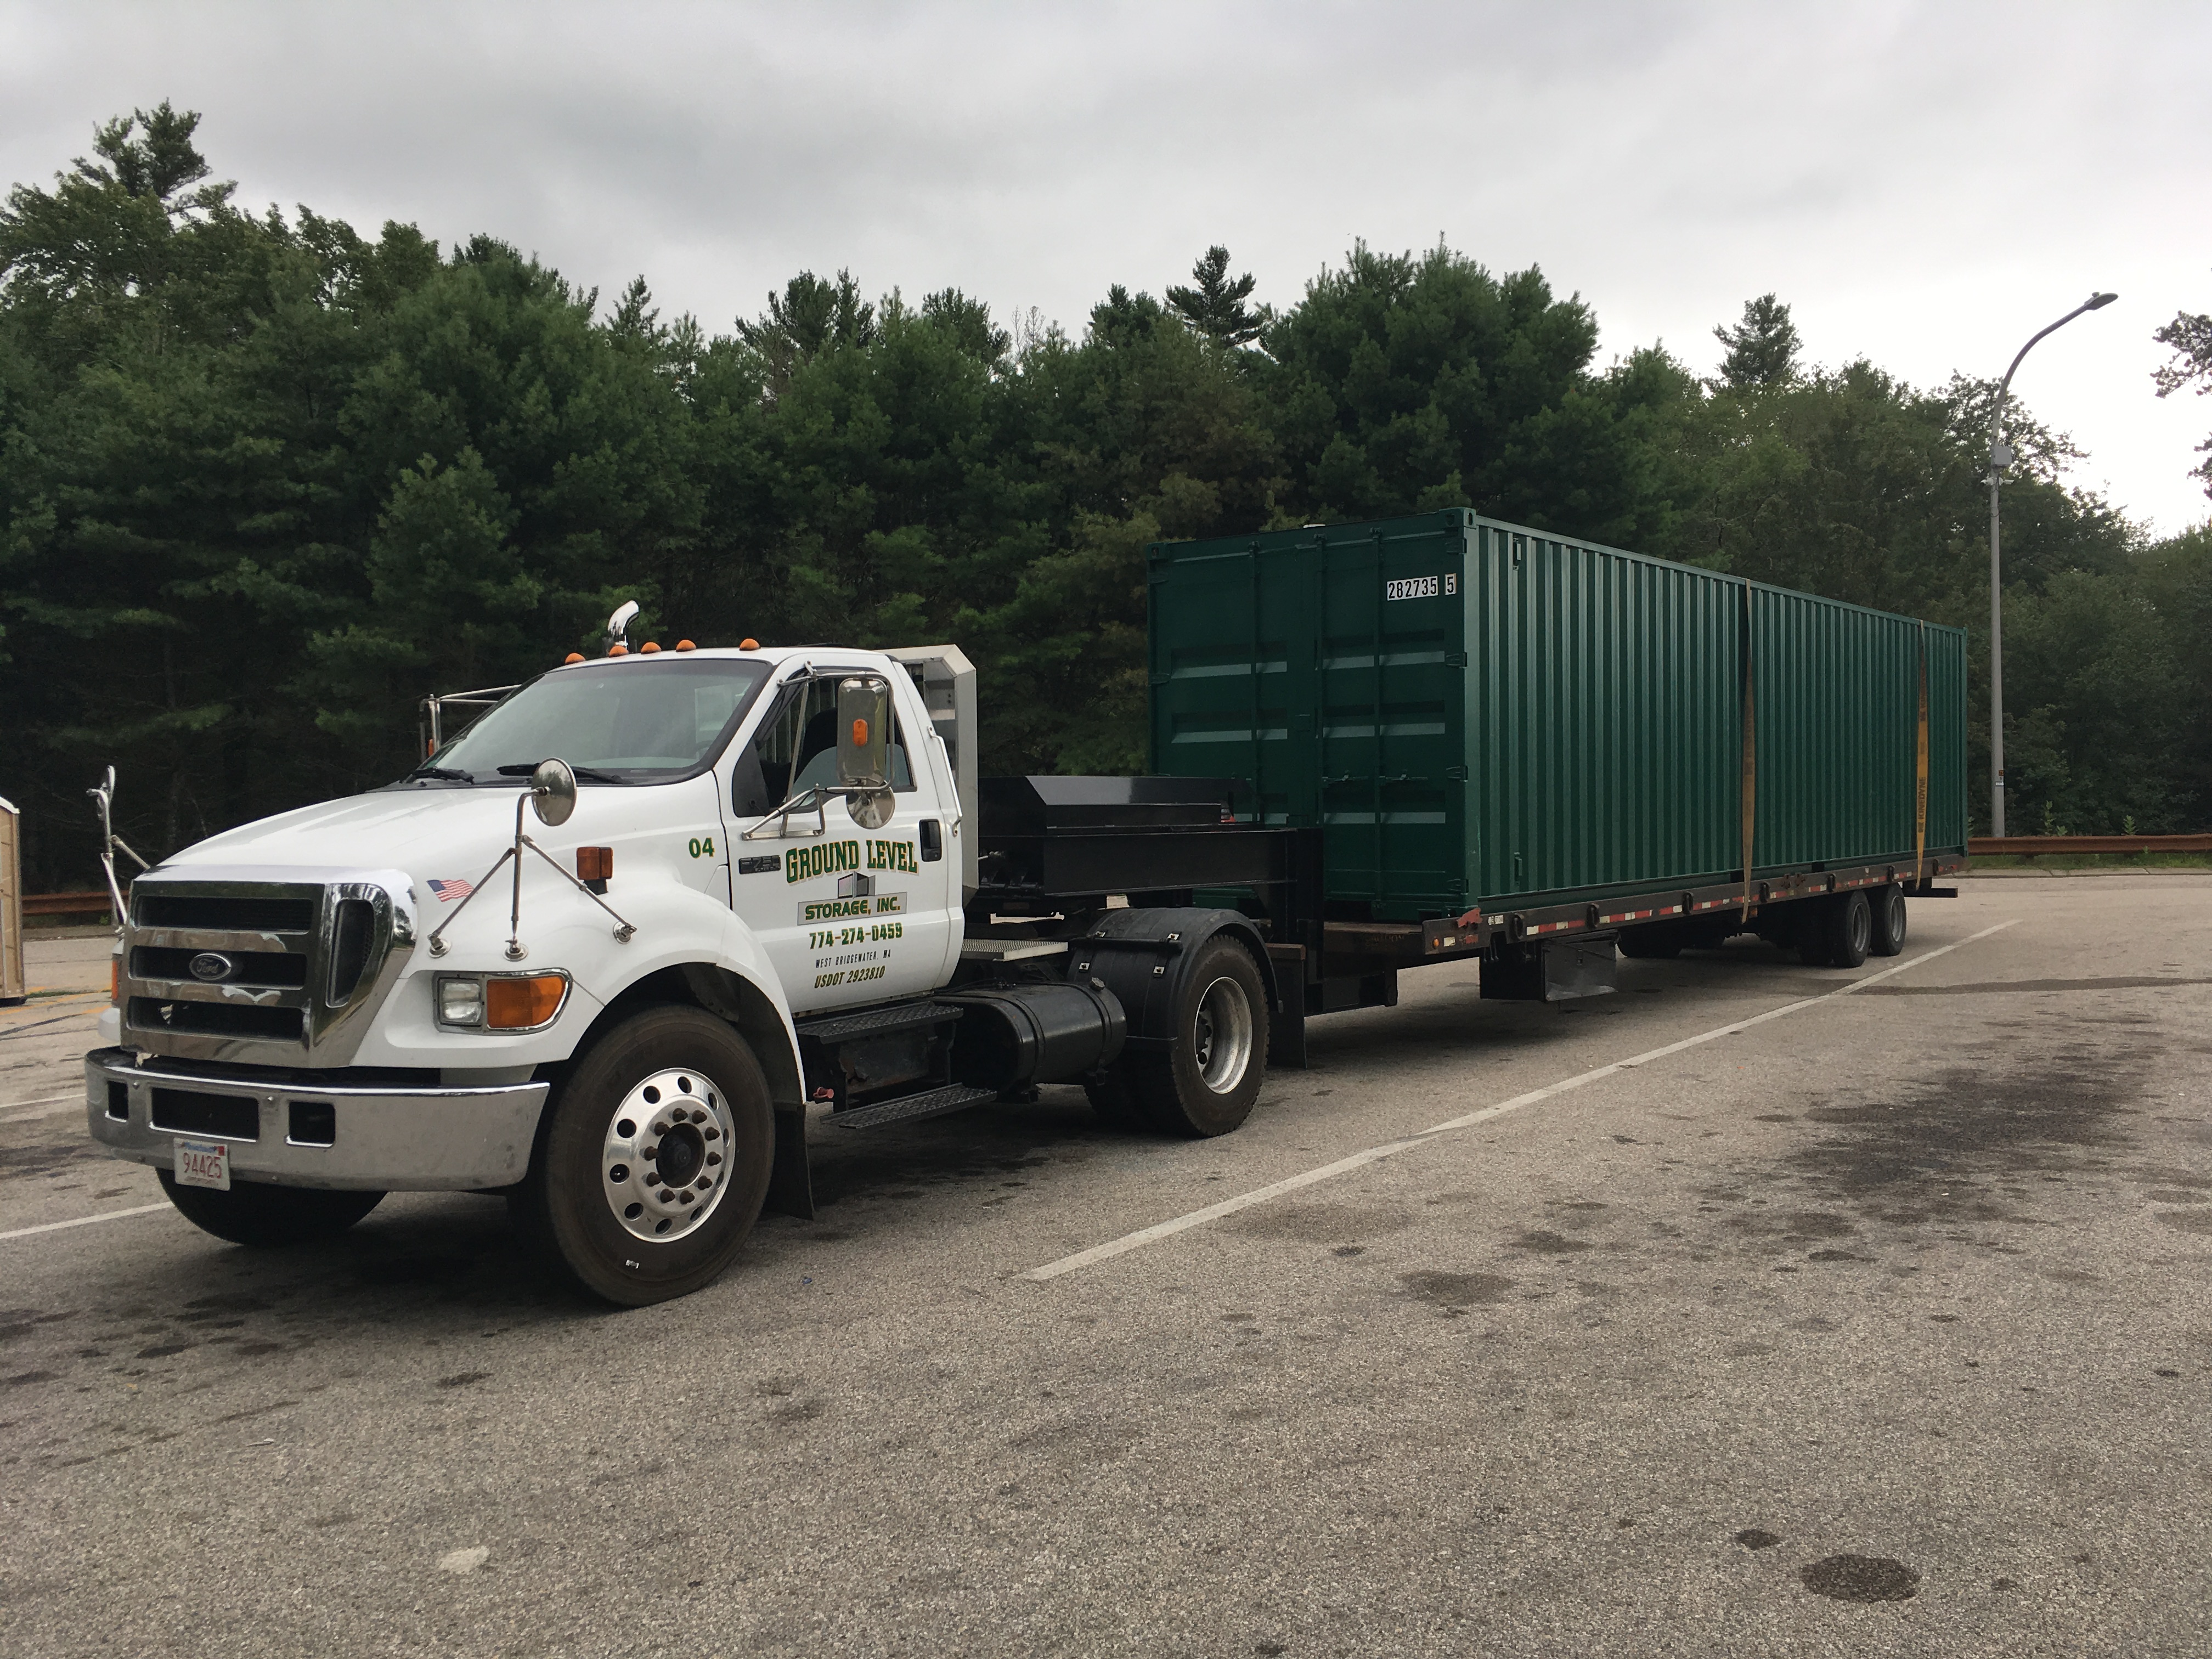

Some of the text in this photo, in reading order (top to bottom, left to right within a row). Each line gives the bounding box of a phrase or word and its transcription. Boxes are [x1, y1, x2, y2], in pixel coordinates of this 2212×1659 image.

[1388, 575, 1454, 599] 282735 5
[689, 837, 715, 859] 04
[786, 839, 918, 884] GROUND LEVEL
[805, 896, 901, 920] STORAGE, INC.
[809, 922, 903, 950] 774-274-0459
[196, 958, 219, 974] Ford
[816, 957, 832, 968] WEST
[883, 949, 891, 958] MA
[814, 965, 885, 989] USDOT 2923810
[183, 1152, 222, 1179] 94425
